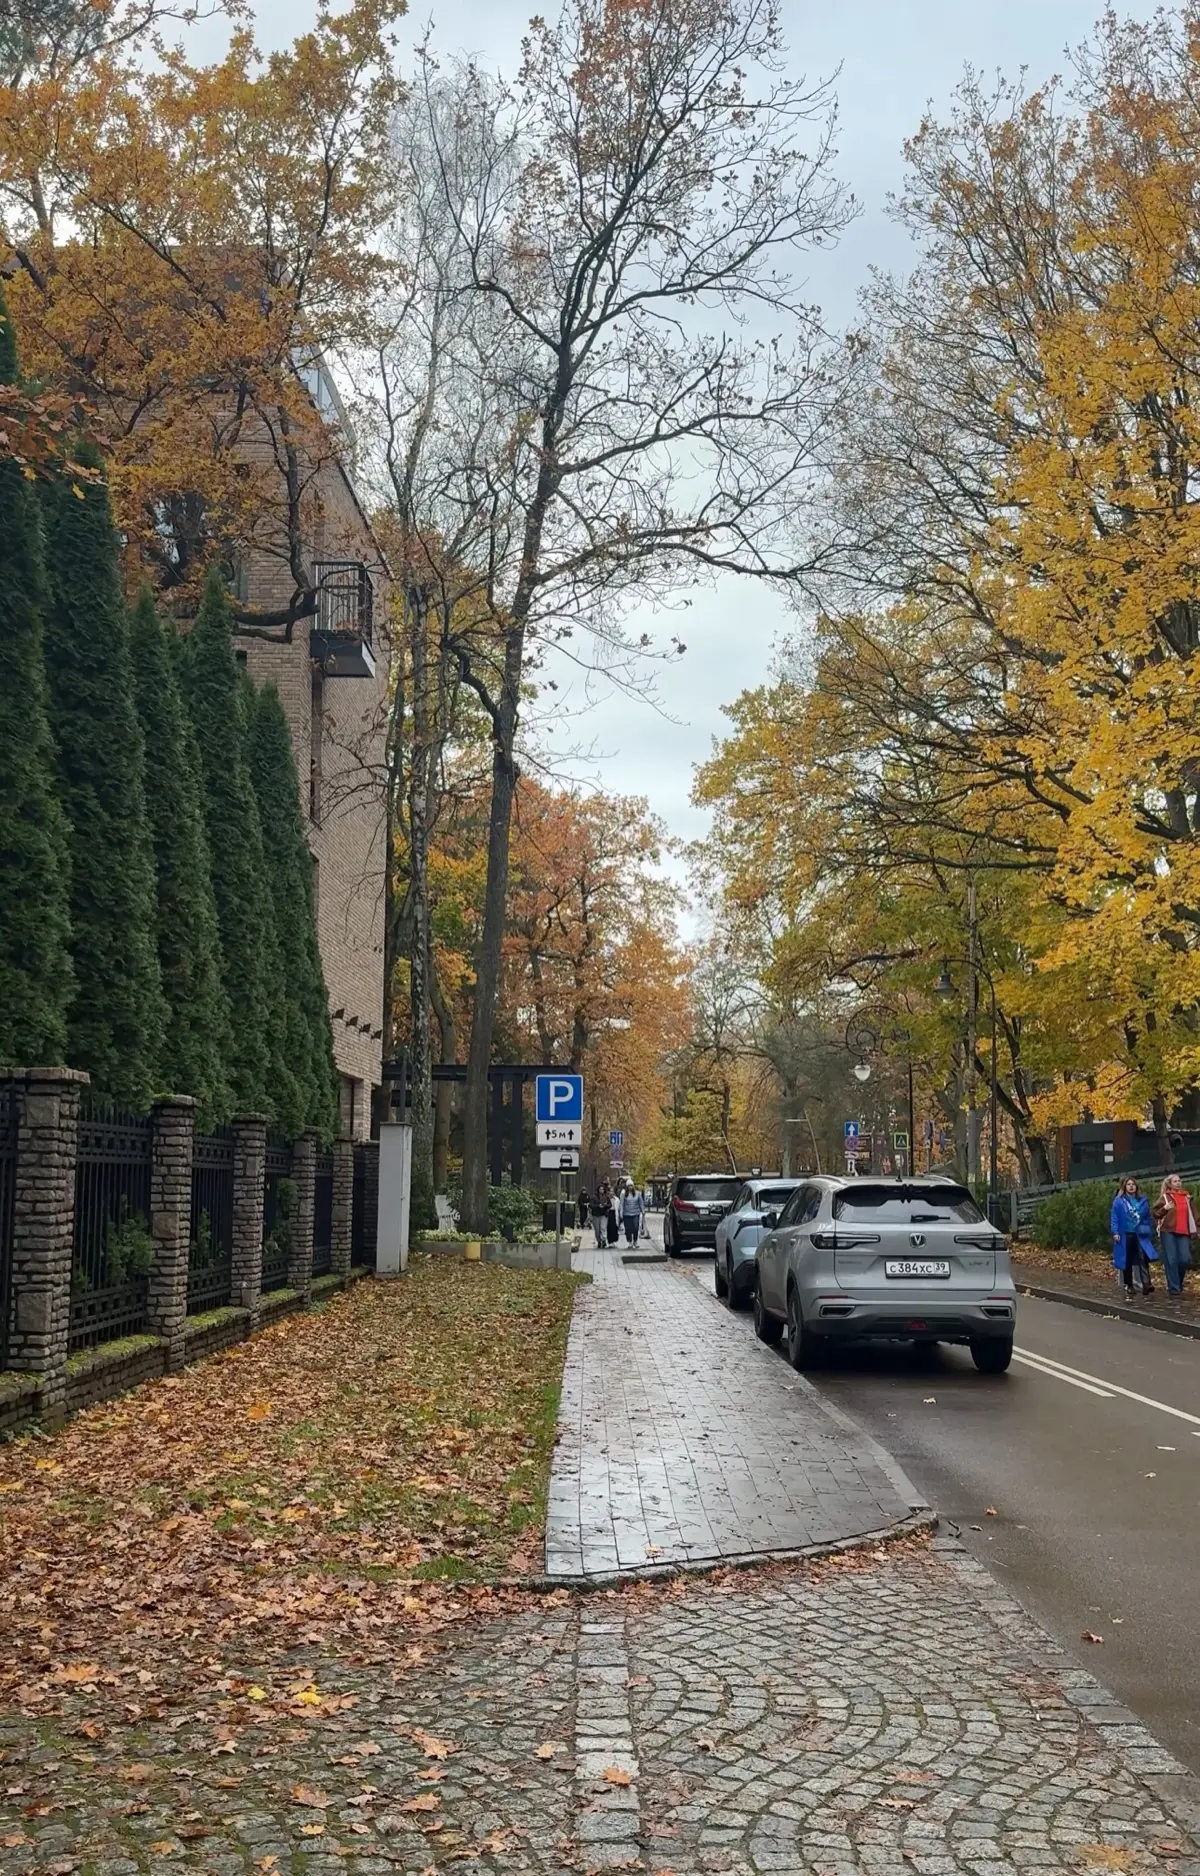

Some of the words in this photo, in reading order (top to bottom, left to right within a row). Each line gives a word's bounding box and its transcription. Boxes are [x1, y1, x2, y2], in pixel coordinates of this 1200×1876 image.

[550, 1081, 574, 1116] P
[551, 1130, 557, 1138] 5
[935, 1262, 946, 1271] 39
